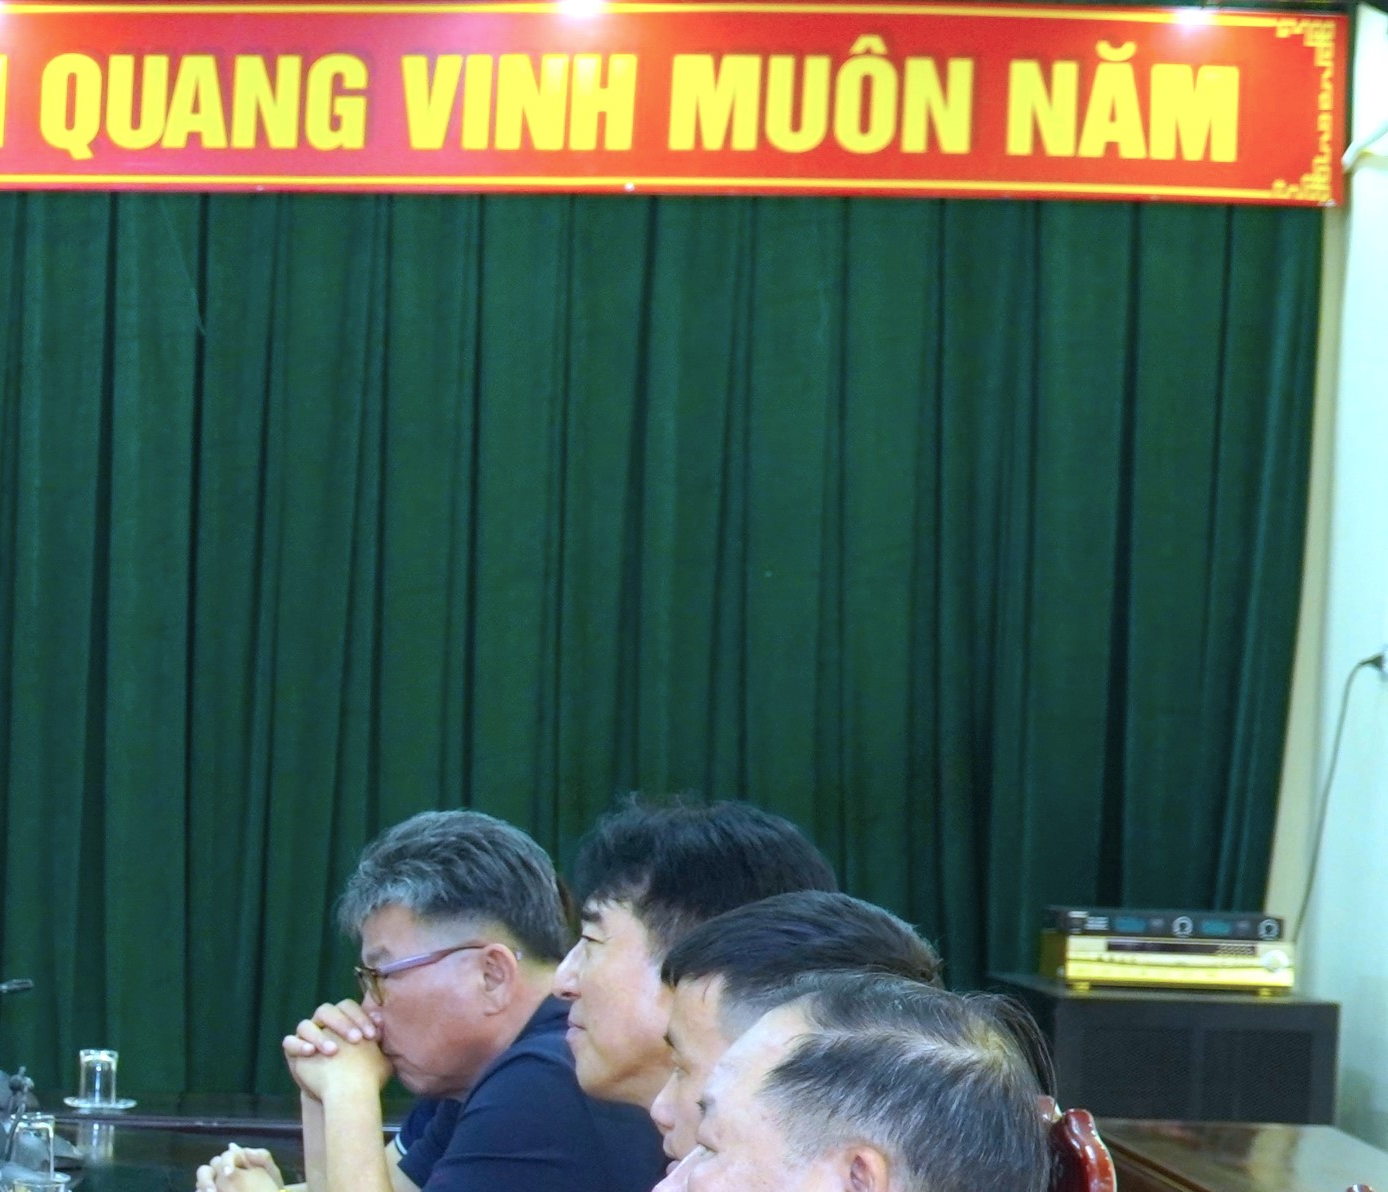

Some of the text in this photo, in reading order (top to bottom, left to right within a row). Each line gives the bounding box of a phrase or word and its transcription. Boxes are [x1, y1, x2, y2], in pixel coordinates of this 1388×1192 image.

[38, 52, 369, 161] QUANG
[402, 54, 639, 152] VINH
[668, 35, 974, 155] MUÔN
[1006, 42, 1240, 163] NĂM
